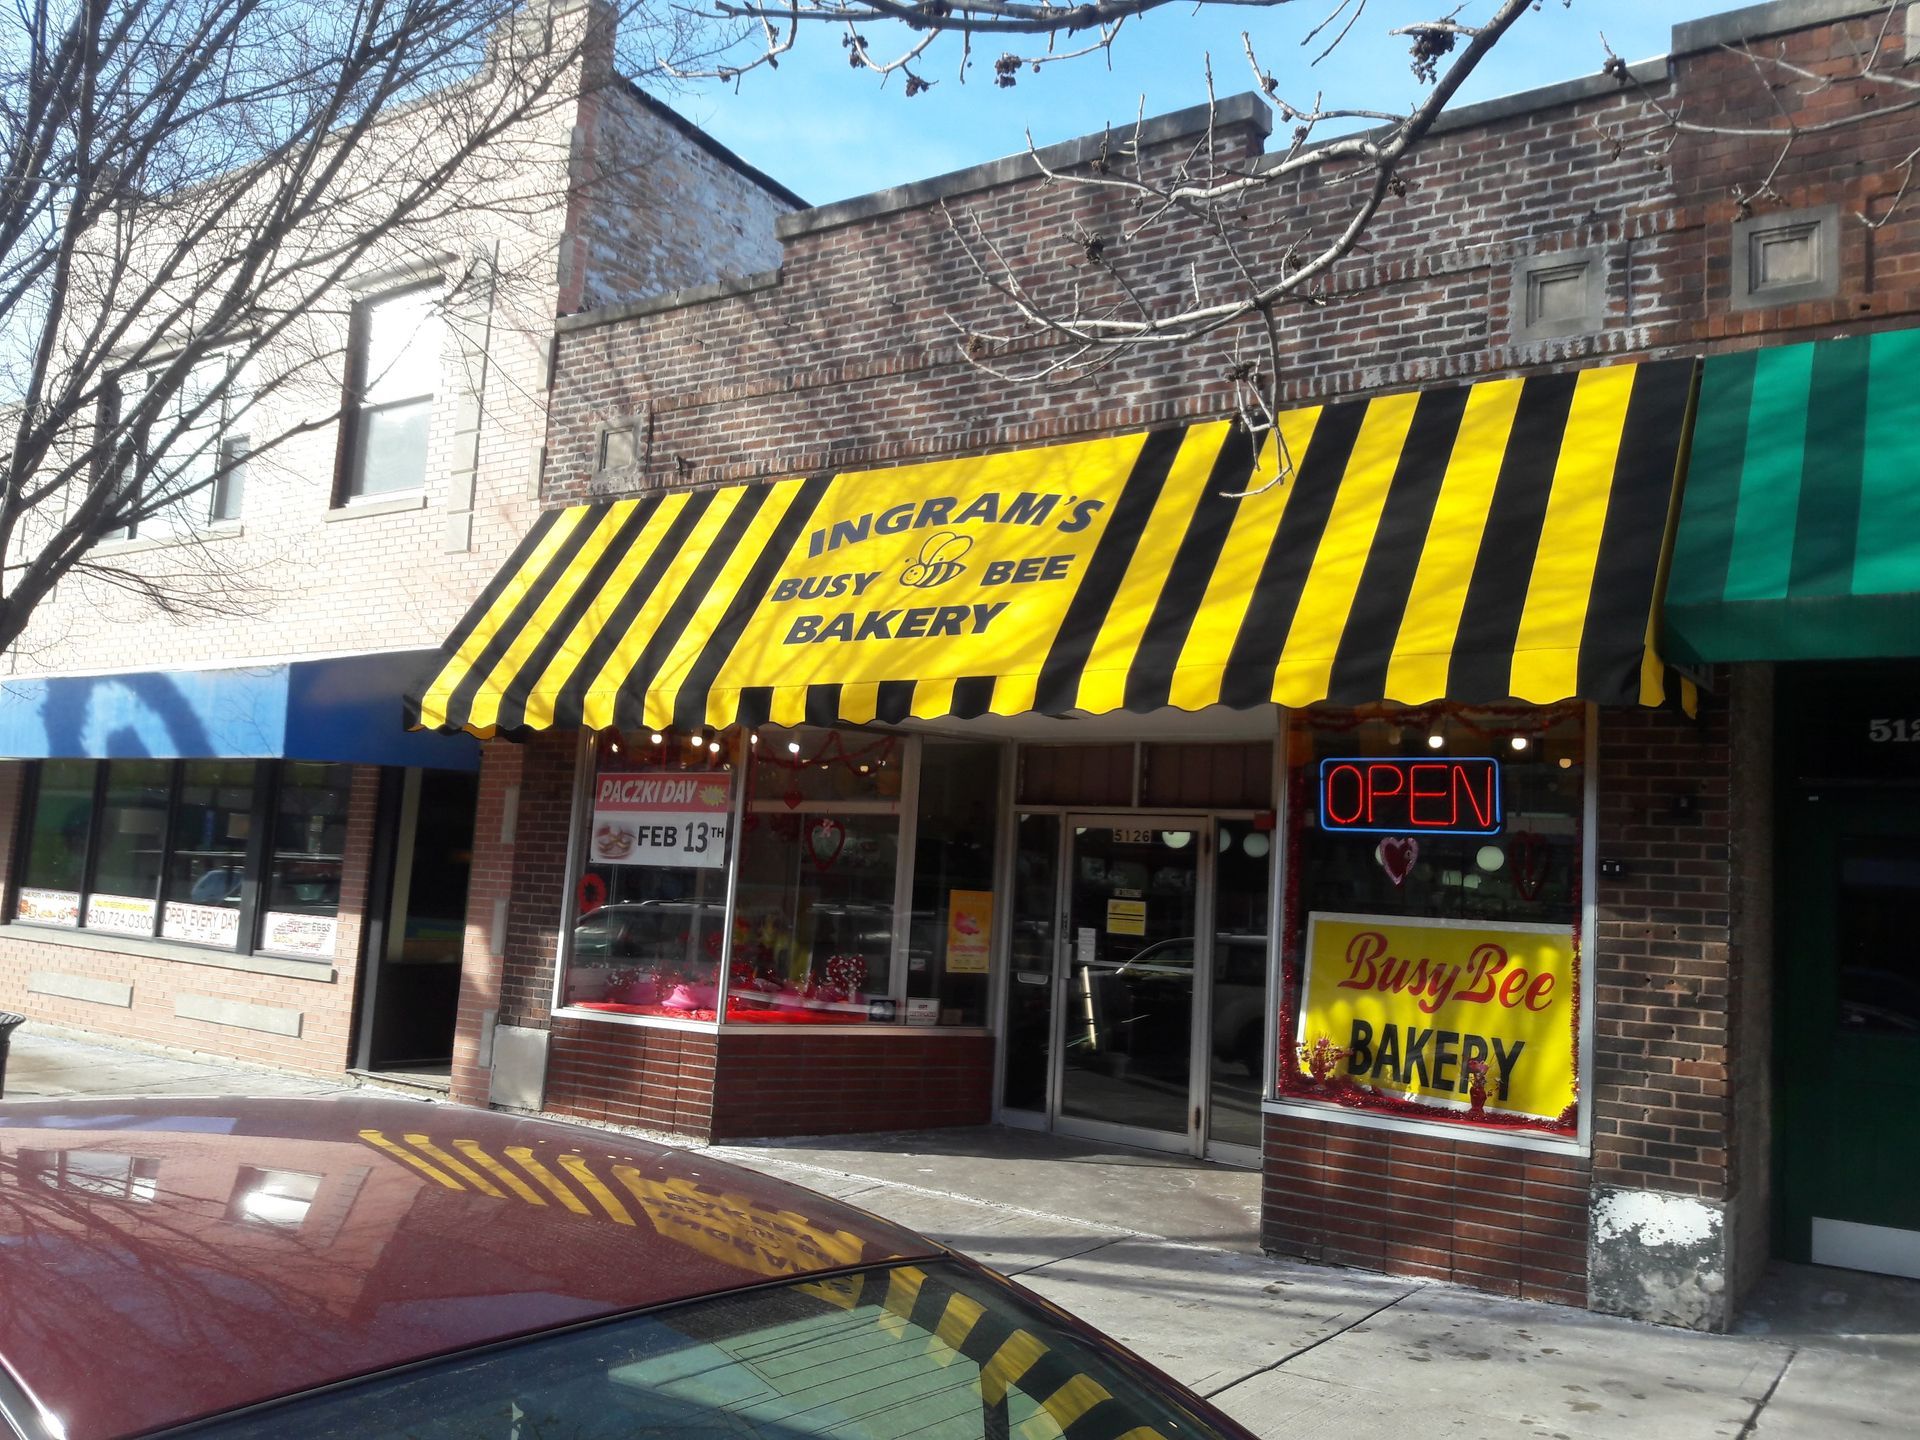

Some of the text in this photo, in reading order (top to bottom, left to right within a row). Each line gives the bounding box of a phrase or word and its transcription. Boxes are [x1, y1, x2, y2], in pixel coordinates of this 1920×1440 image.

[808, 492, 1105, 558] INGRAM'S
[770, 554, 1076, 602] BUSY BEE
[783, 602, 1011, 645] BAKERY
[600, 780, 698, 803] PACZKI DAY
[1328, 765, 1492, 826] OPEN
[637, 826, 678, 847] FEB
[1114, 829, 1150, 842] 5126
[86, 909, 153, 930] 630.724.0300
[164, 906, 188, 924] OPEN
[190, 909, 219, 928] EVERY
[221, 912, 240, 930] DAY
[1337, 932, 1555, 1014] Busy Bee
[1347, 1019, 1525, 1102] BAKERY
